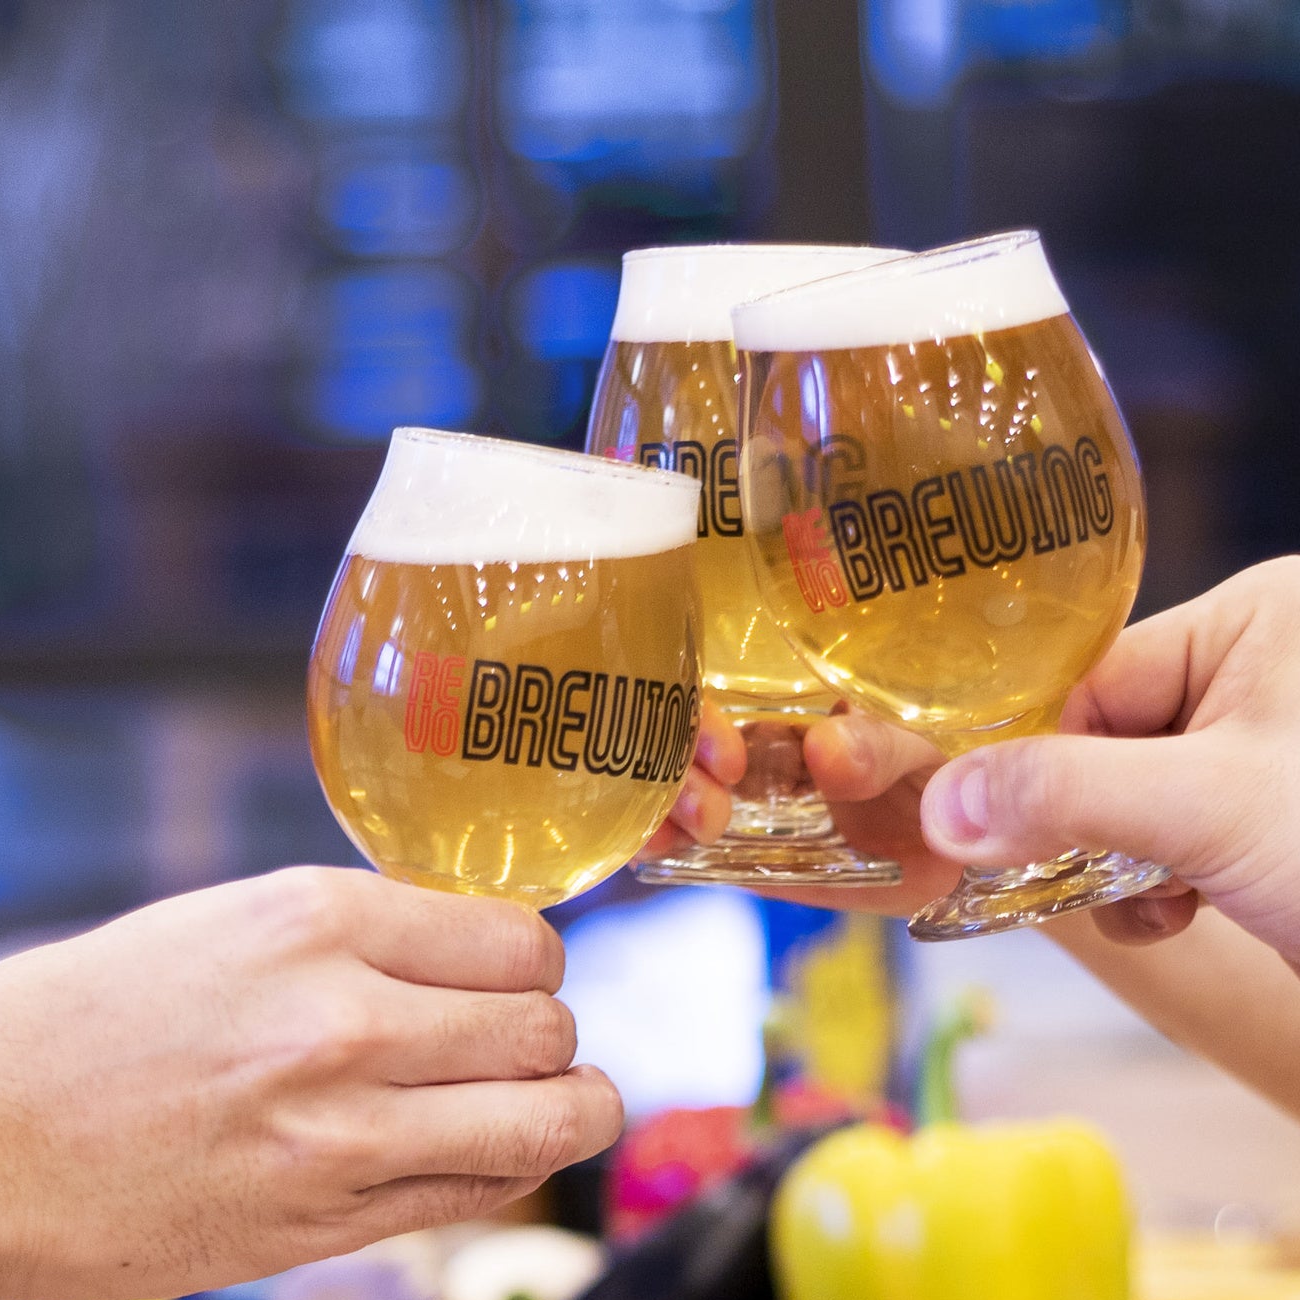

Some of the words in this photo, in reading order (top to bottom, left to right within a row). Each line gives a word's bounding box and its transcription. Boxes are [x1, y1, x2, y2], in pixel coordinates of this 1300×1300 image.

[828, 436, 1115, 603] BREWING
[414, 652, 466, 708] RE
[461, 659, 698, 783] BREWING
